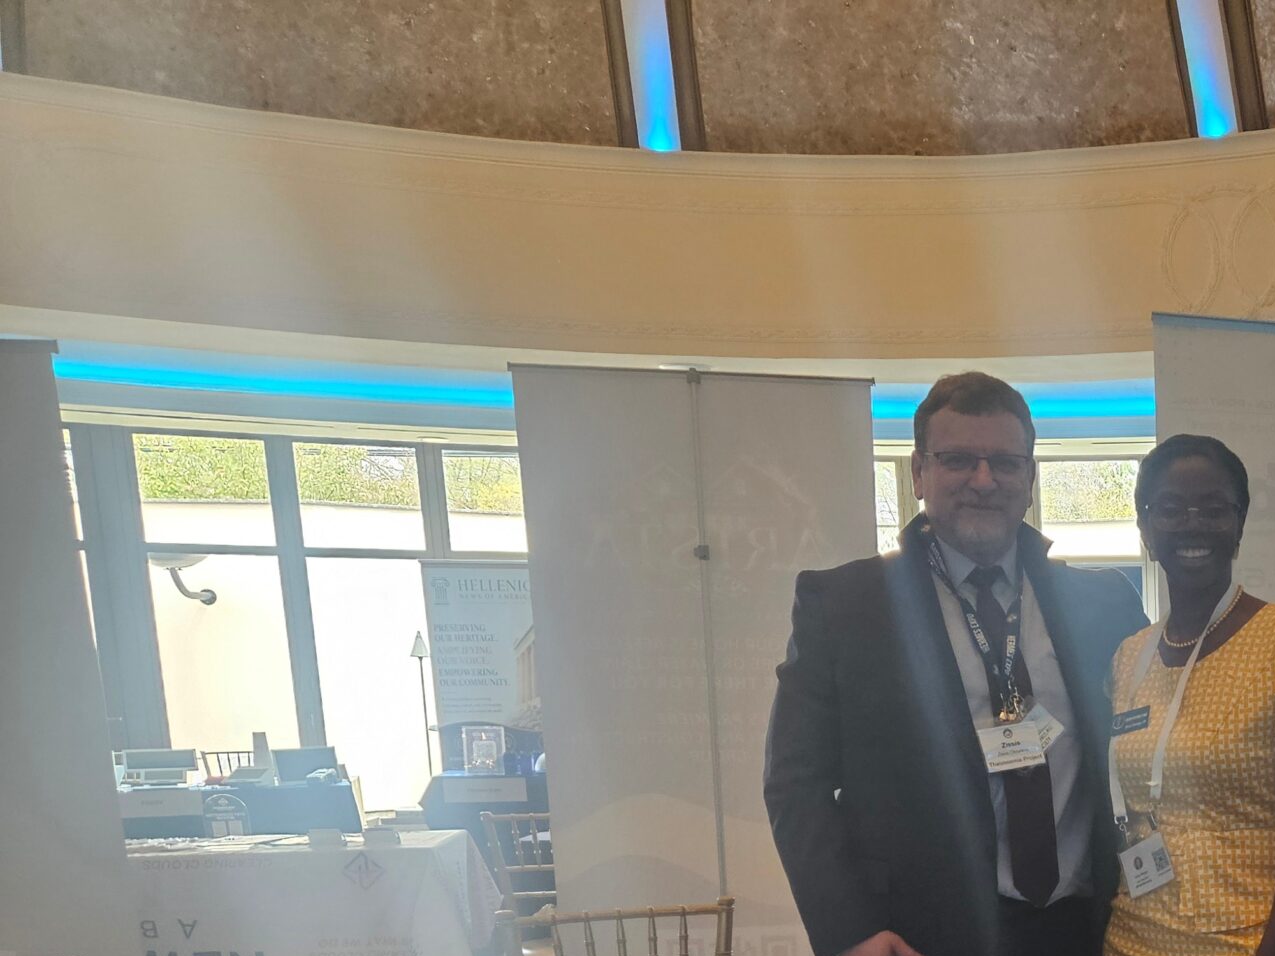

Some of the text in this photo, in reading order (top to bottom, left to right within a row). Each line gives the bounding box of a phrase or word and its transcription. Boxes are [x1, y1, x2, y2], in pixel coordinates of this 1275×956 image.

[433, 624, 486, 633] PRESERVING
[434, 634, 452, 642] OUR
[439, 668, 499, 678] EMPOWERING
[440, 679, 457, 688] OUR
[141, 858, 200, 871] CLOUDS
